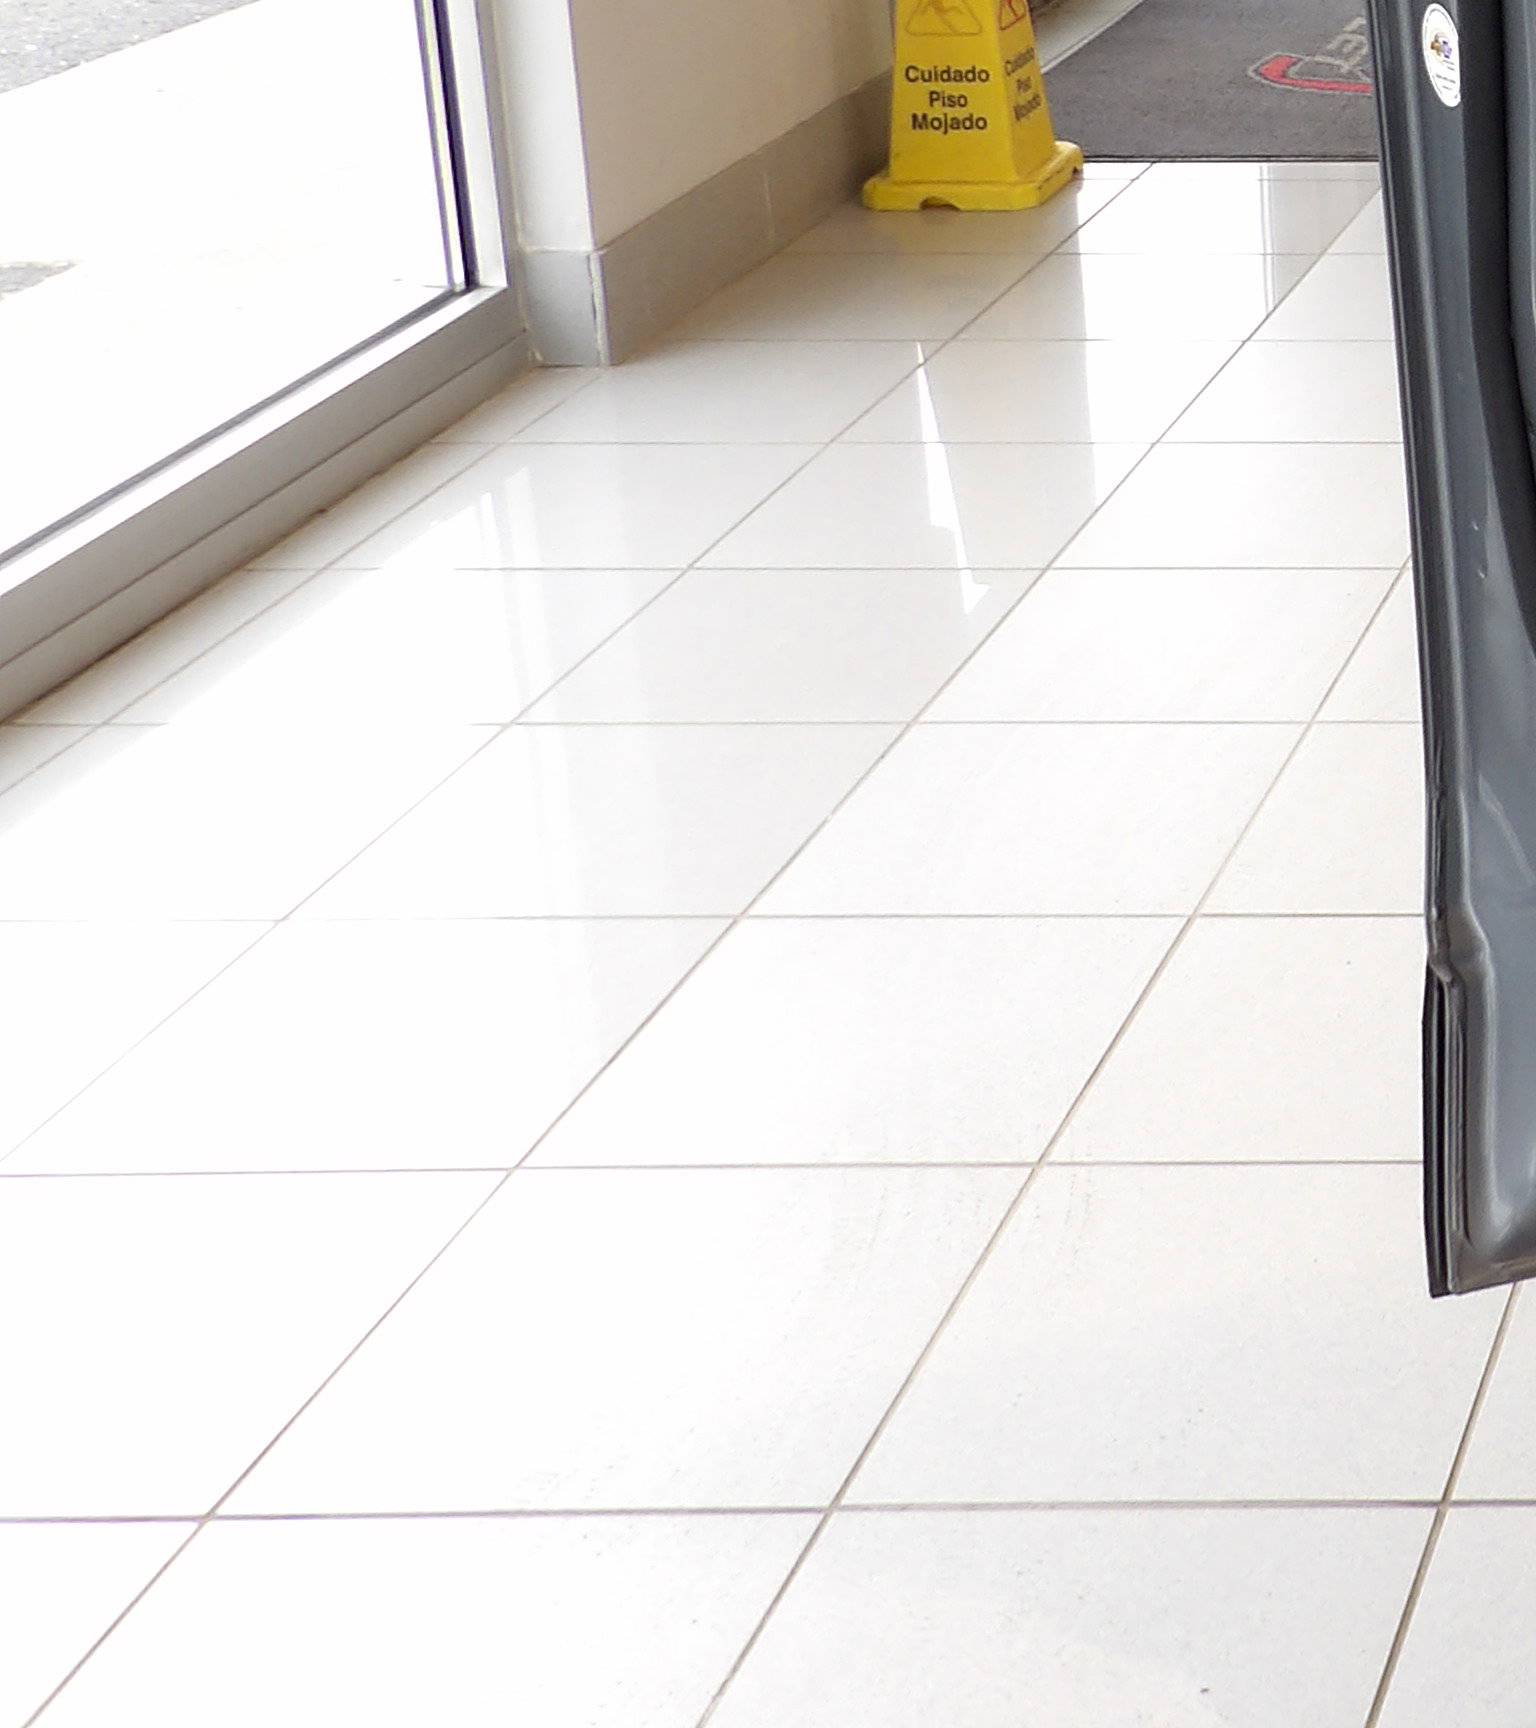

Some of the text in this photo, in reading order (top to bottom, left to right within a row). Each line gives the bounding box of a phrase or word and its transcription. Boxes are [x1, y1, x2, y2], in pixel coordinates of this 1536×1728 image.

[904, 64, 991, 83] Cuidado
[928, 90, 969, 108] Piso
[911, 112, 988, 136] Mojado
